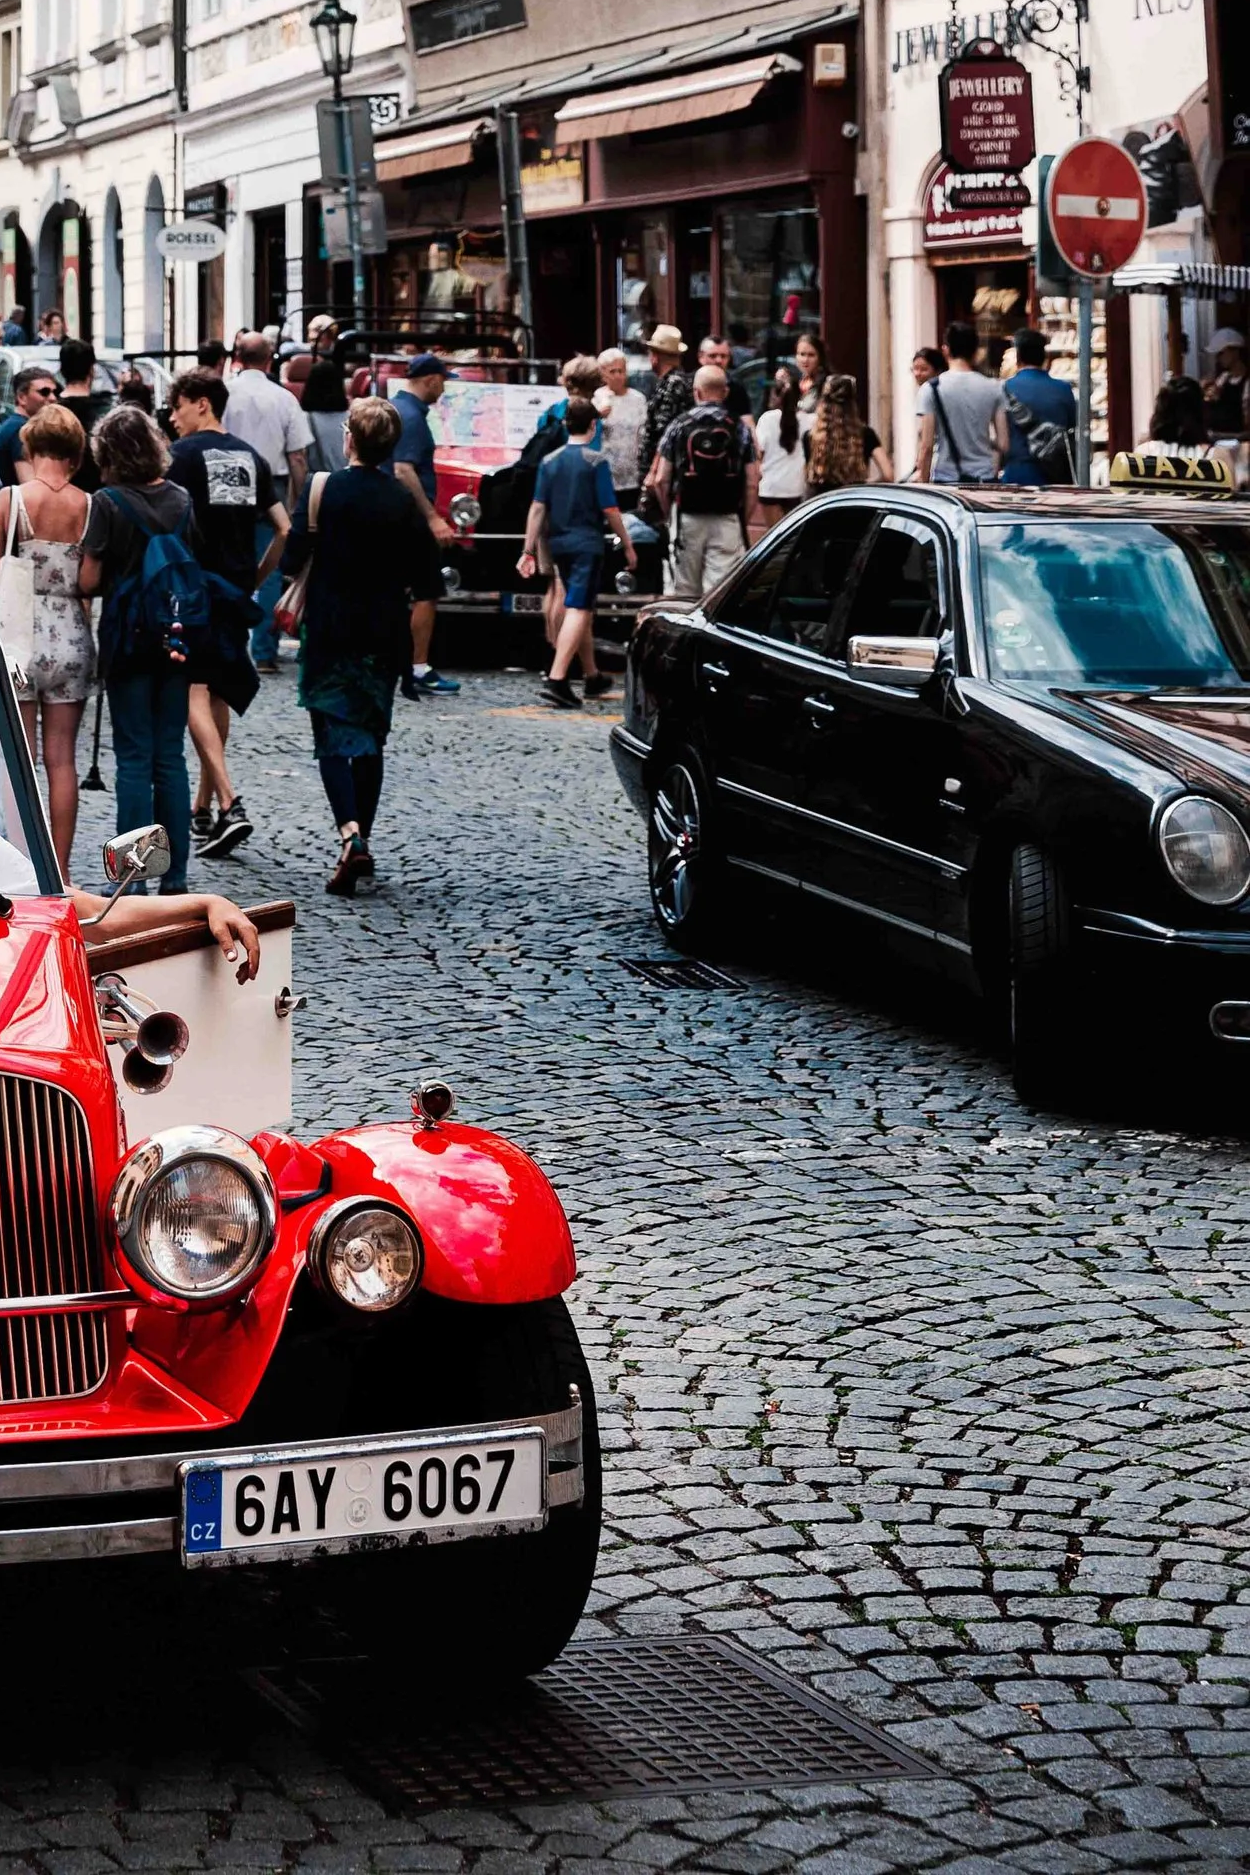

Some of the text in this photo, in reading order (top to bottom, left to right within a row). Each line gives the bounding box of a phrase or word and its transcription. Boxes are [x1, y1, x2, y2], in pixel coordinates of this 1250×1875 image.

[949, 76, 1025, 101] JEWELLERY
[166, 232, 216, 244] ROESEL
[1126, 452, 1223, 480] TAXI
[235, 1449, 515, 1537] 6AY 6067
[191, 1522, 217, 1541] CZ
